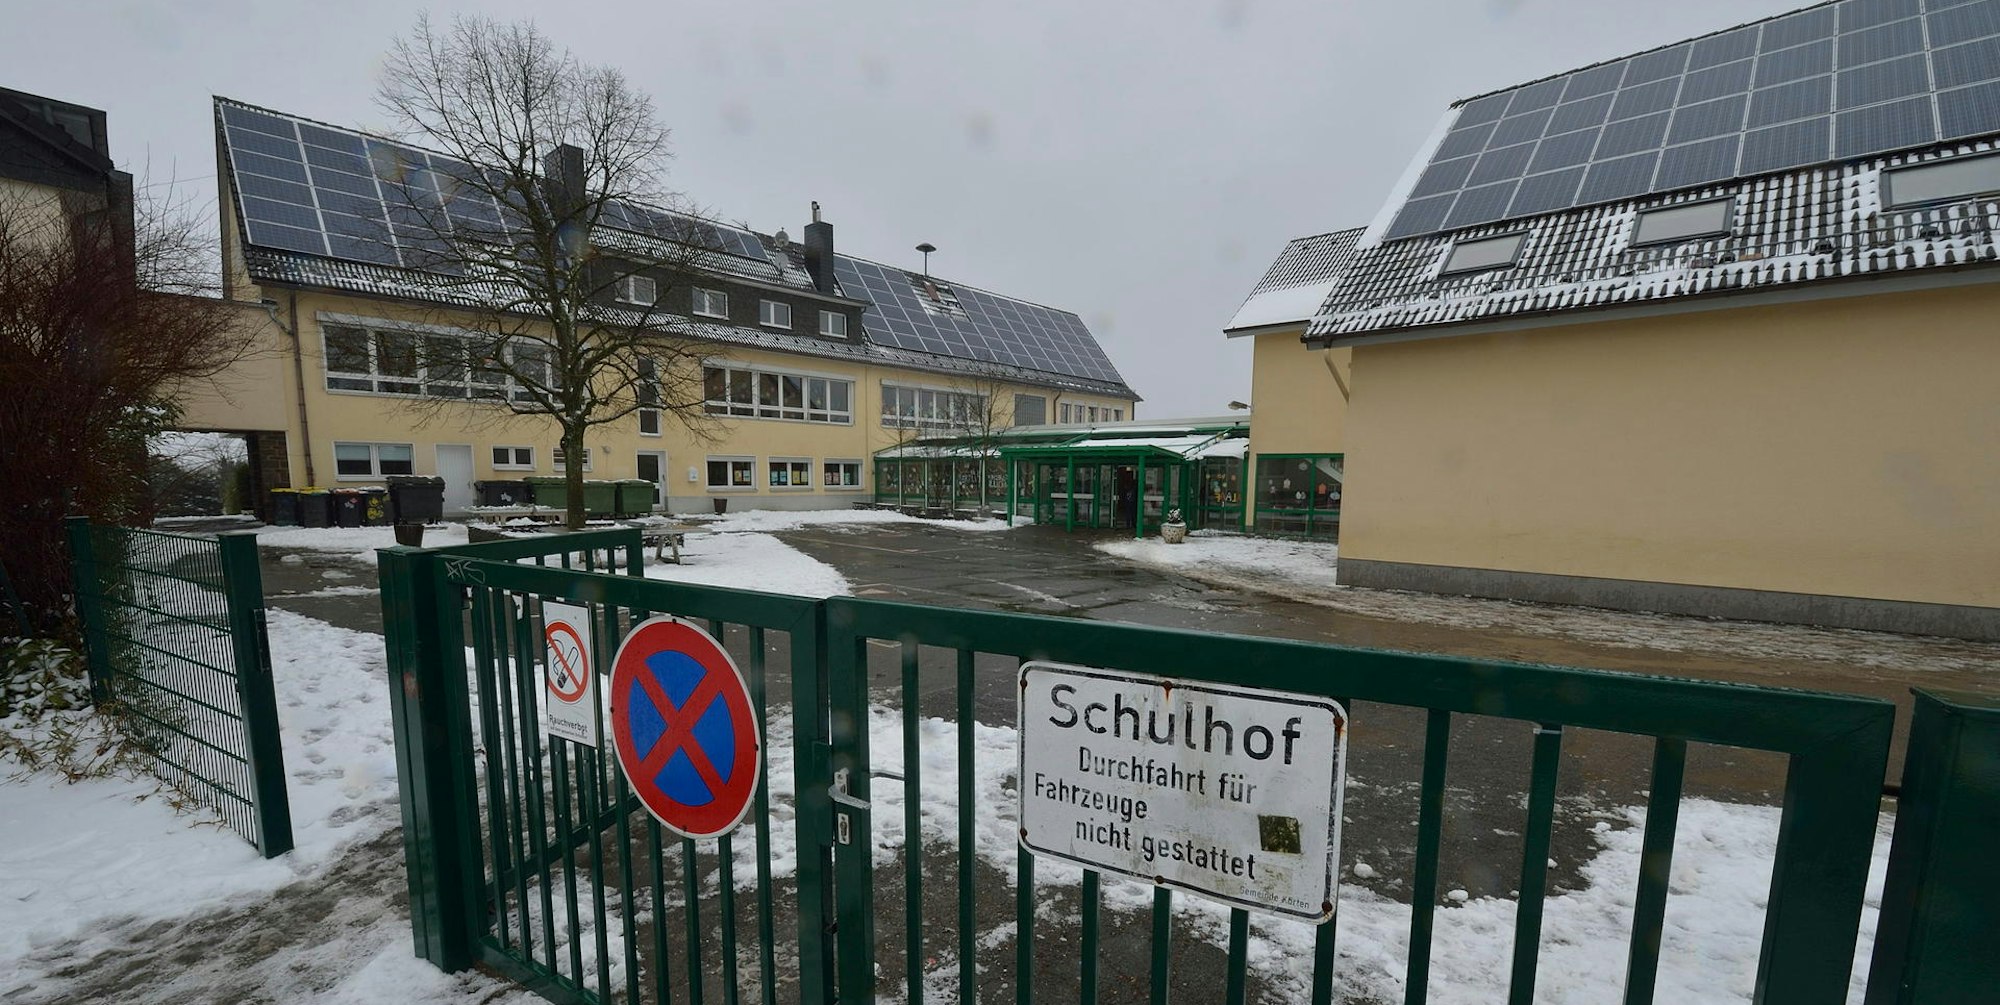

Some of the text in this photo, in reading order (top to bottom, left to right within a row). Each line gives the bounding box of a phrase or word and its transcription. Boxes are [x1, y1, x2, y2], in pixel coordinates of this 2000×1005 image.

[1049, 683, 1303, 765] Schulhof
[1034, 772, 1149, 823] Fahrzeuge
[1079, 745, 1258, 804] Durchfahrt für
[1075, 819, 1257, 881] nicht gestattet
